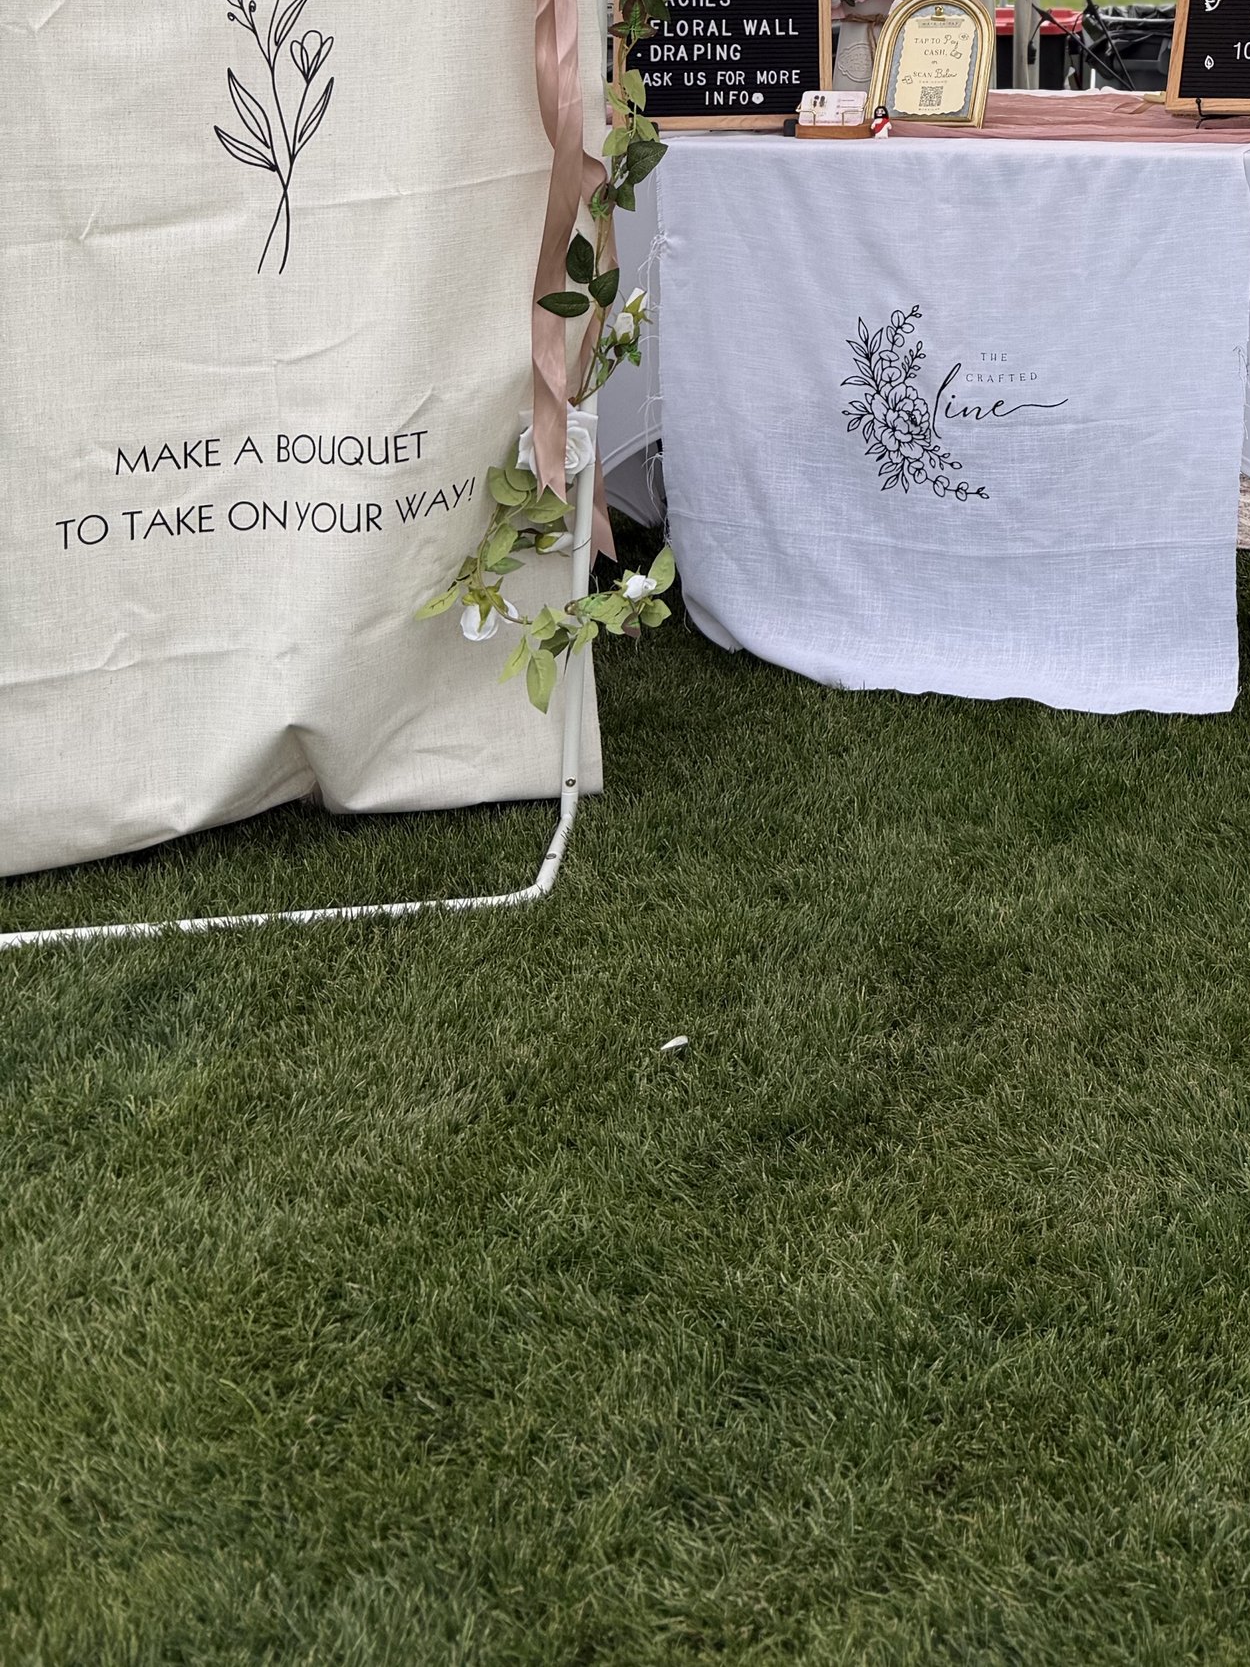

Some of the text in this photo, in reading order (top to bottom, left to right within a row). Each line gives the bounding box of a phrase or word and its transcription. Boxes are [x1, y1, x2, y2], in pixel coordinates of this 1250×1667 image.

[650, 18, 799, 37] FLORAL WALL
[650, 42, 742, 62] DRAPING
[643, 69, 800, 87] ASK US FOR MORE
[705, 90, 749, 106] INFO
[981, 352, 1008, 362] THE
[966, 372, 1038, 383] CRAFTED
[115, 430, 428, 476] MAKE A BOUQUET
[55, 514, 109, 549] TO
[122, 503, 215, 541] TAKE
[396, 476, 476, 525] WAY!
